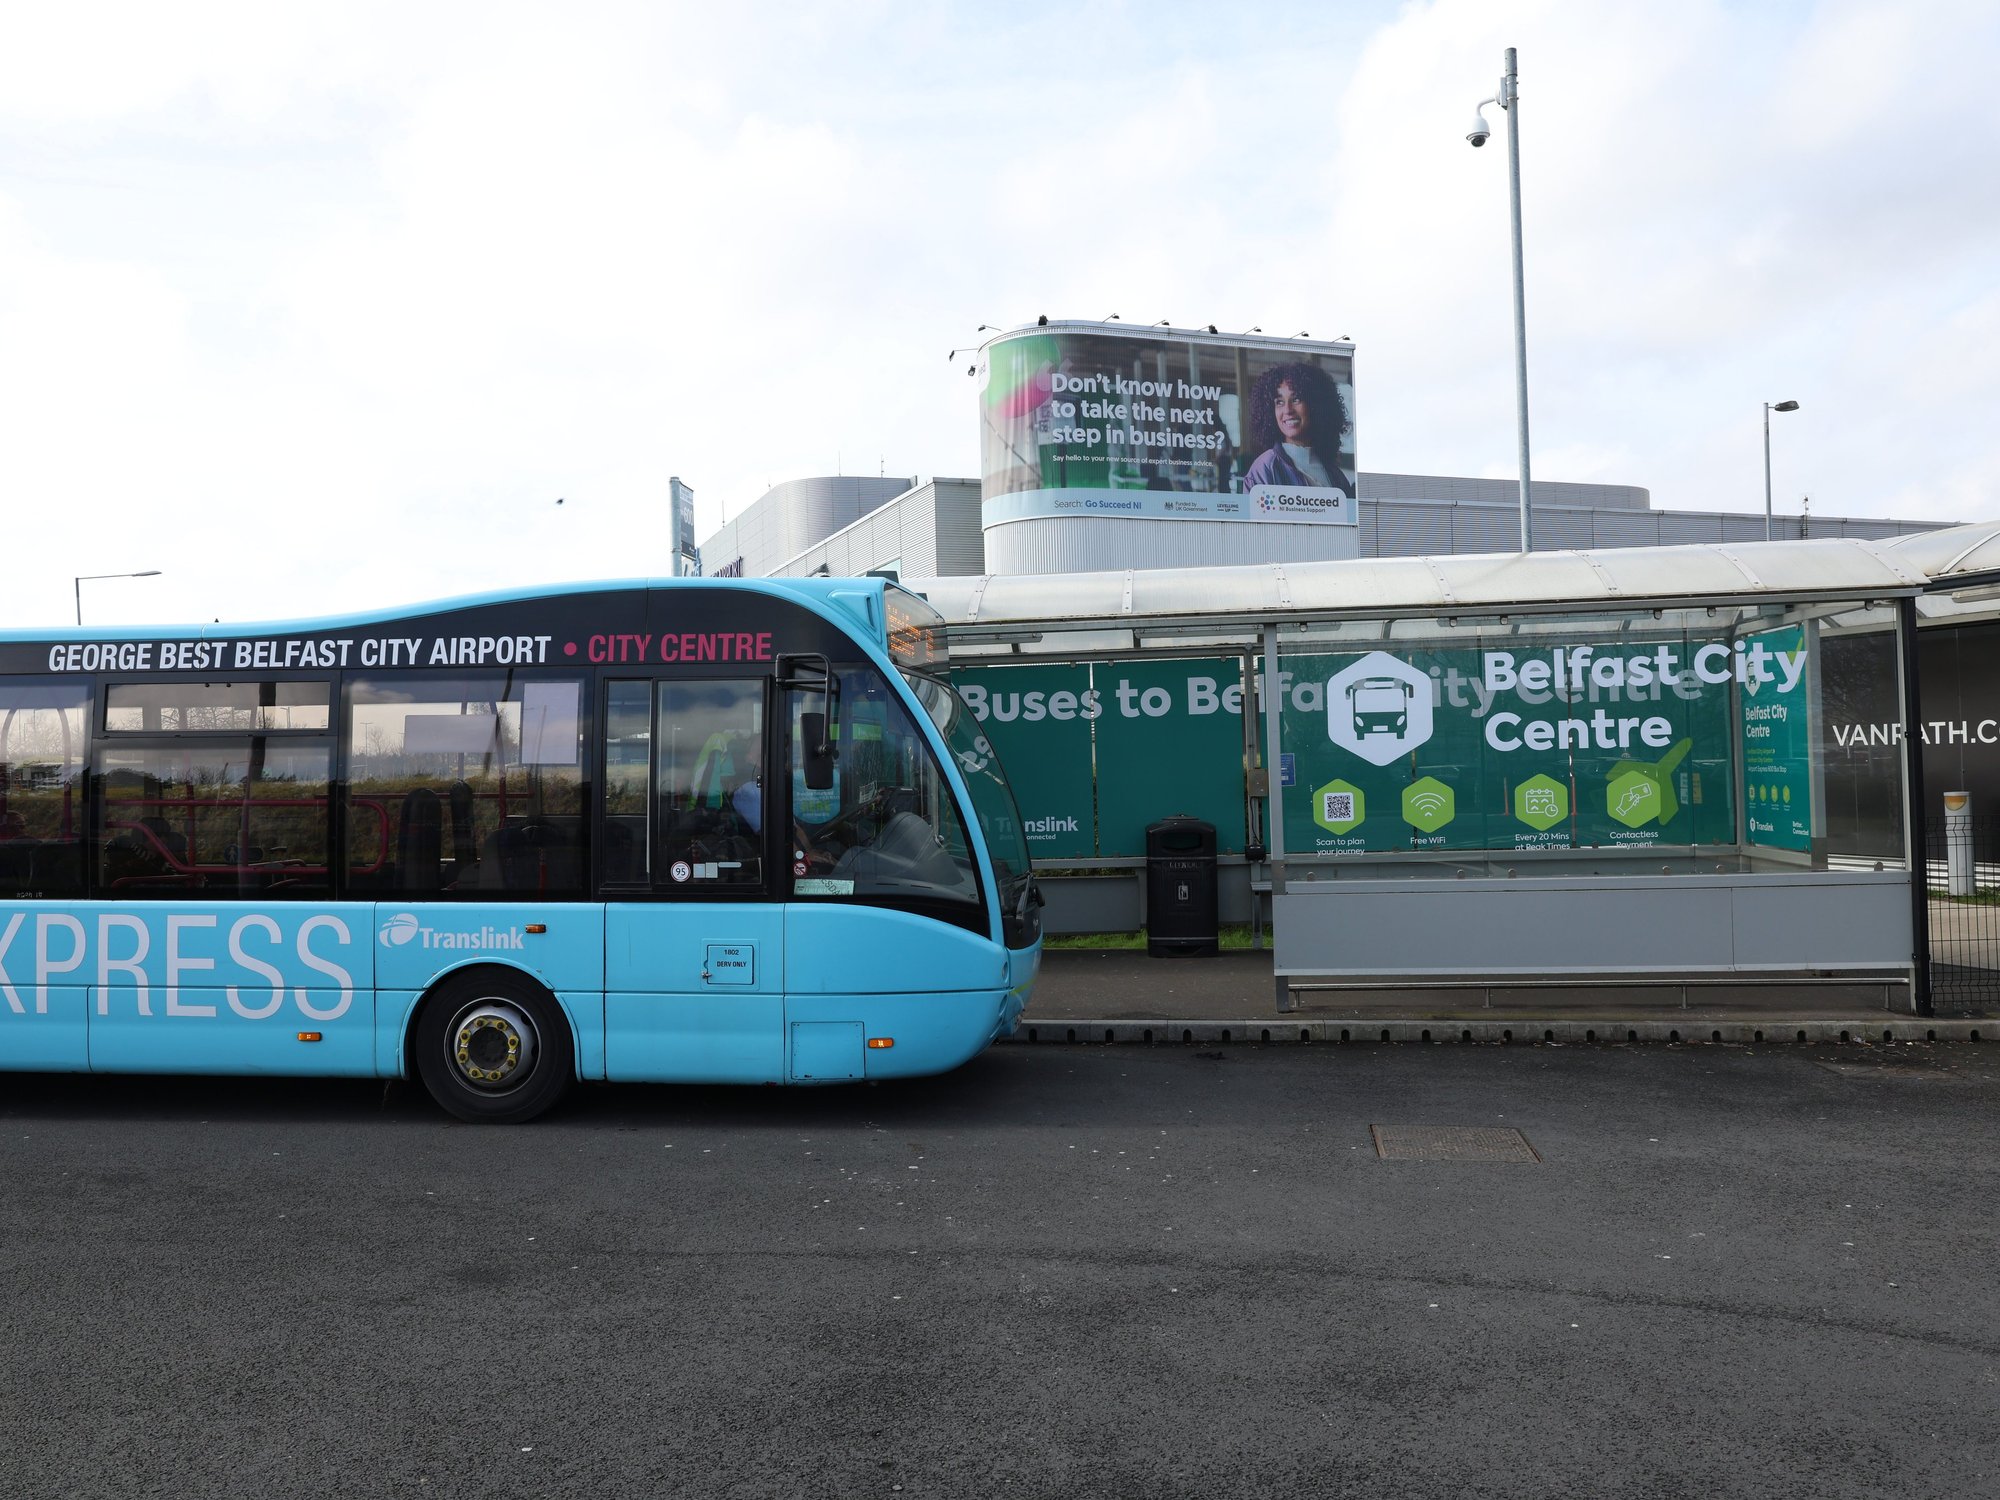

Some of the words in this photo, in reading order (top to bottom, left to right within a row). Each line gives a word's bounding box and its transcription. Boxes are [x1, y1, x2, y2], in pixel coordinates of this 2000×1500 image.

[1052, 373, 1110, 394] Don't
[1115, 374, 1173, 398] know
[1178, 379, 1221, 401] how
[1051, 400, 1076, 418] to
[1080, 399, 1128, 420] take
[1132, 401, 1166, 422] the
[1170, 407, 1214, 425] next
[1052, 425, 1101, 447] step
[1106, 424, 1124, 445] in
[1130, 425, 1225, 450] business?
[1052, 454, 1064, 463] Say
[1148, 458, 1168, 466] expert
[1168, 458, 1192, 466] business
[1054, 500, 1083, 509] Search:
[1085, 500, 1098, 508] Go
[1099, 500, 1131, 509] Succeed
[1133, 501, 1142, 510] NI
[1278, 494, 1295, 506] Go
[1295, 495, 1339, 508] Succeed
[48, 643, 153, 671] GEORGE
[159, 641, 228, 670] BEST
[234, 639, 353, 669] BELFAST
[360, 637, 422, 666] CITY
[429, 635, 552, 665] AIRPORT
[588, 633, 654, 663] CITY
[660, 632, 772, 662] CENTRE
[1484, 645, 1680, 691] Belfast
[1694, 640, 1808, 693] City
[958, 685, 1103, 722] Buses
[1116, 678, 1171, 718] to
[1187, 671, 1326, 715] Belfa
[1429, 665, 1497, 718] ity
[1745, 705, 1771, 721] Belfast
[1771, 704, 1787, 722] City
[1485, 708, 1672, 752] Centre
[1746, 724, 1770, 738] Centre
[1832, 719, 2000, 747] VANRATH.C
[1316, 838, 1336, 846] Scan
[1337, 838, 1345, 846] to
[1347, 837, 1365, 847] plan
[1410, 837, 1427, 845] Free
[1428, 836, 1446, 844] WiFi
[1515, 833, 1537, 843] Every
[1539, 833, 1549, 841] 20
[1609, 831, 1659, 839] Contactless
[1546, 842, 1571, 850] Times
[1616, 841, 1653, 849] Payment
[1316, 849, 1335, 857] your
[1335, 848, 1365, 857] journey
[675, 867, 686, 876] 95
[419, 925, 524, 951] Translink
